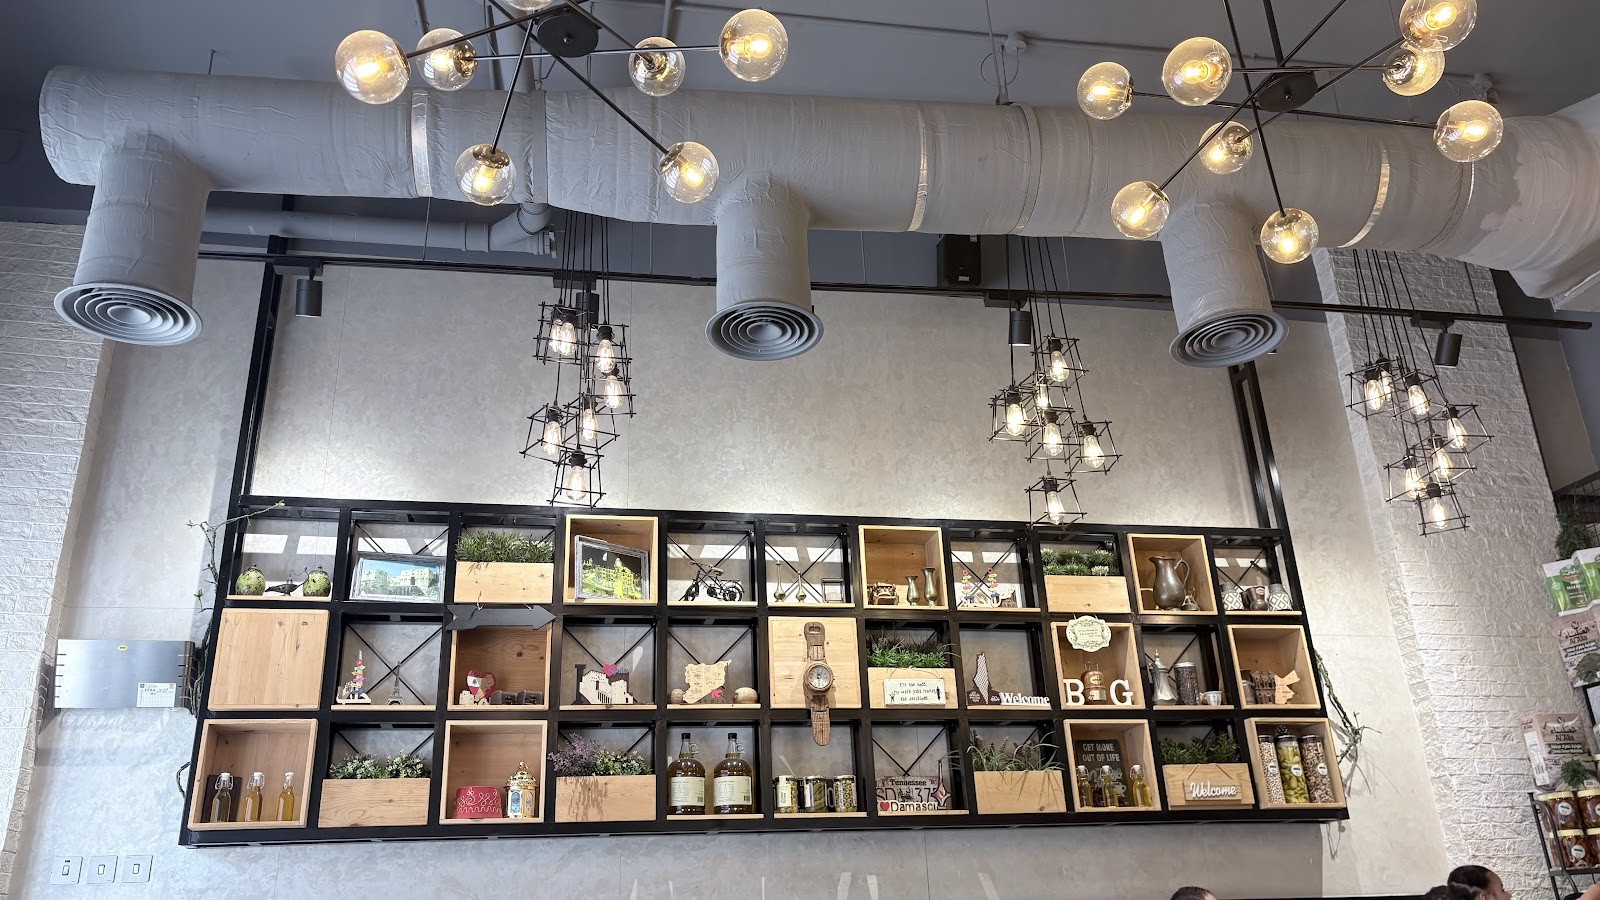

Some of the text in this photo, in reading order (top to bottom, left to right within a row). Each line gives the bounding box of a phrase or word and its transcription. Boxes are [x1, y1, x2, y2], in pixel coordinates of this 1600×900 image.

[1063, 679, 1085, 706] B
[1110, 679, 1134, 706] G
[999, 692, 1051, 705] Welcome
[1082, 743, 1115, 752] GET MORE
[1082, 753, 1120, 762] OUT OF LIFE
[889, 778, 927, 786] Tennessee
[1189, 780, 1237, 798] Welcome
[890, 801, 939, 812] Damasc
